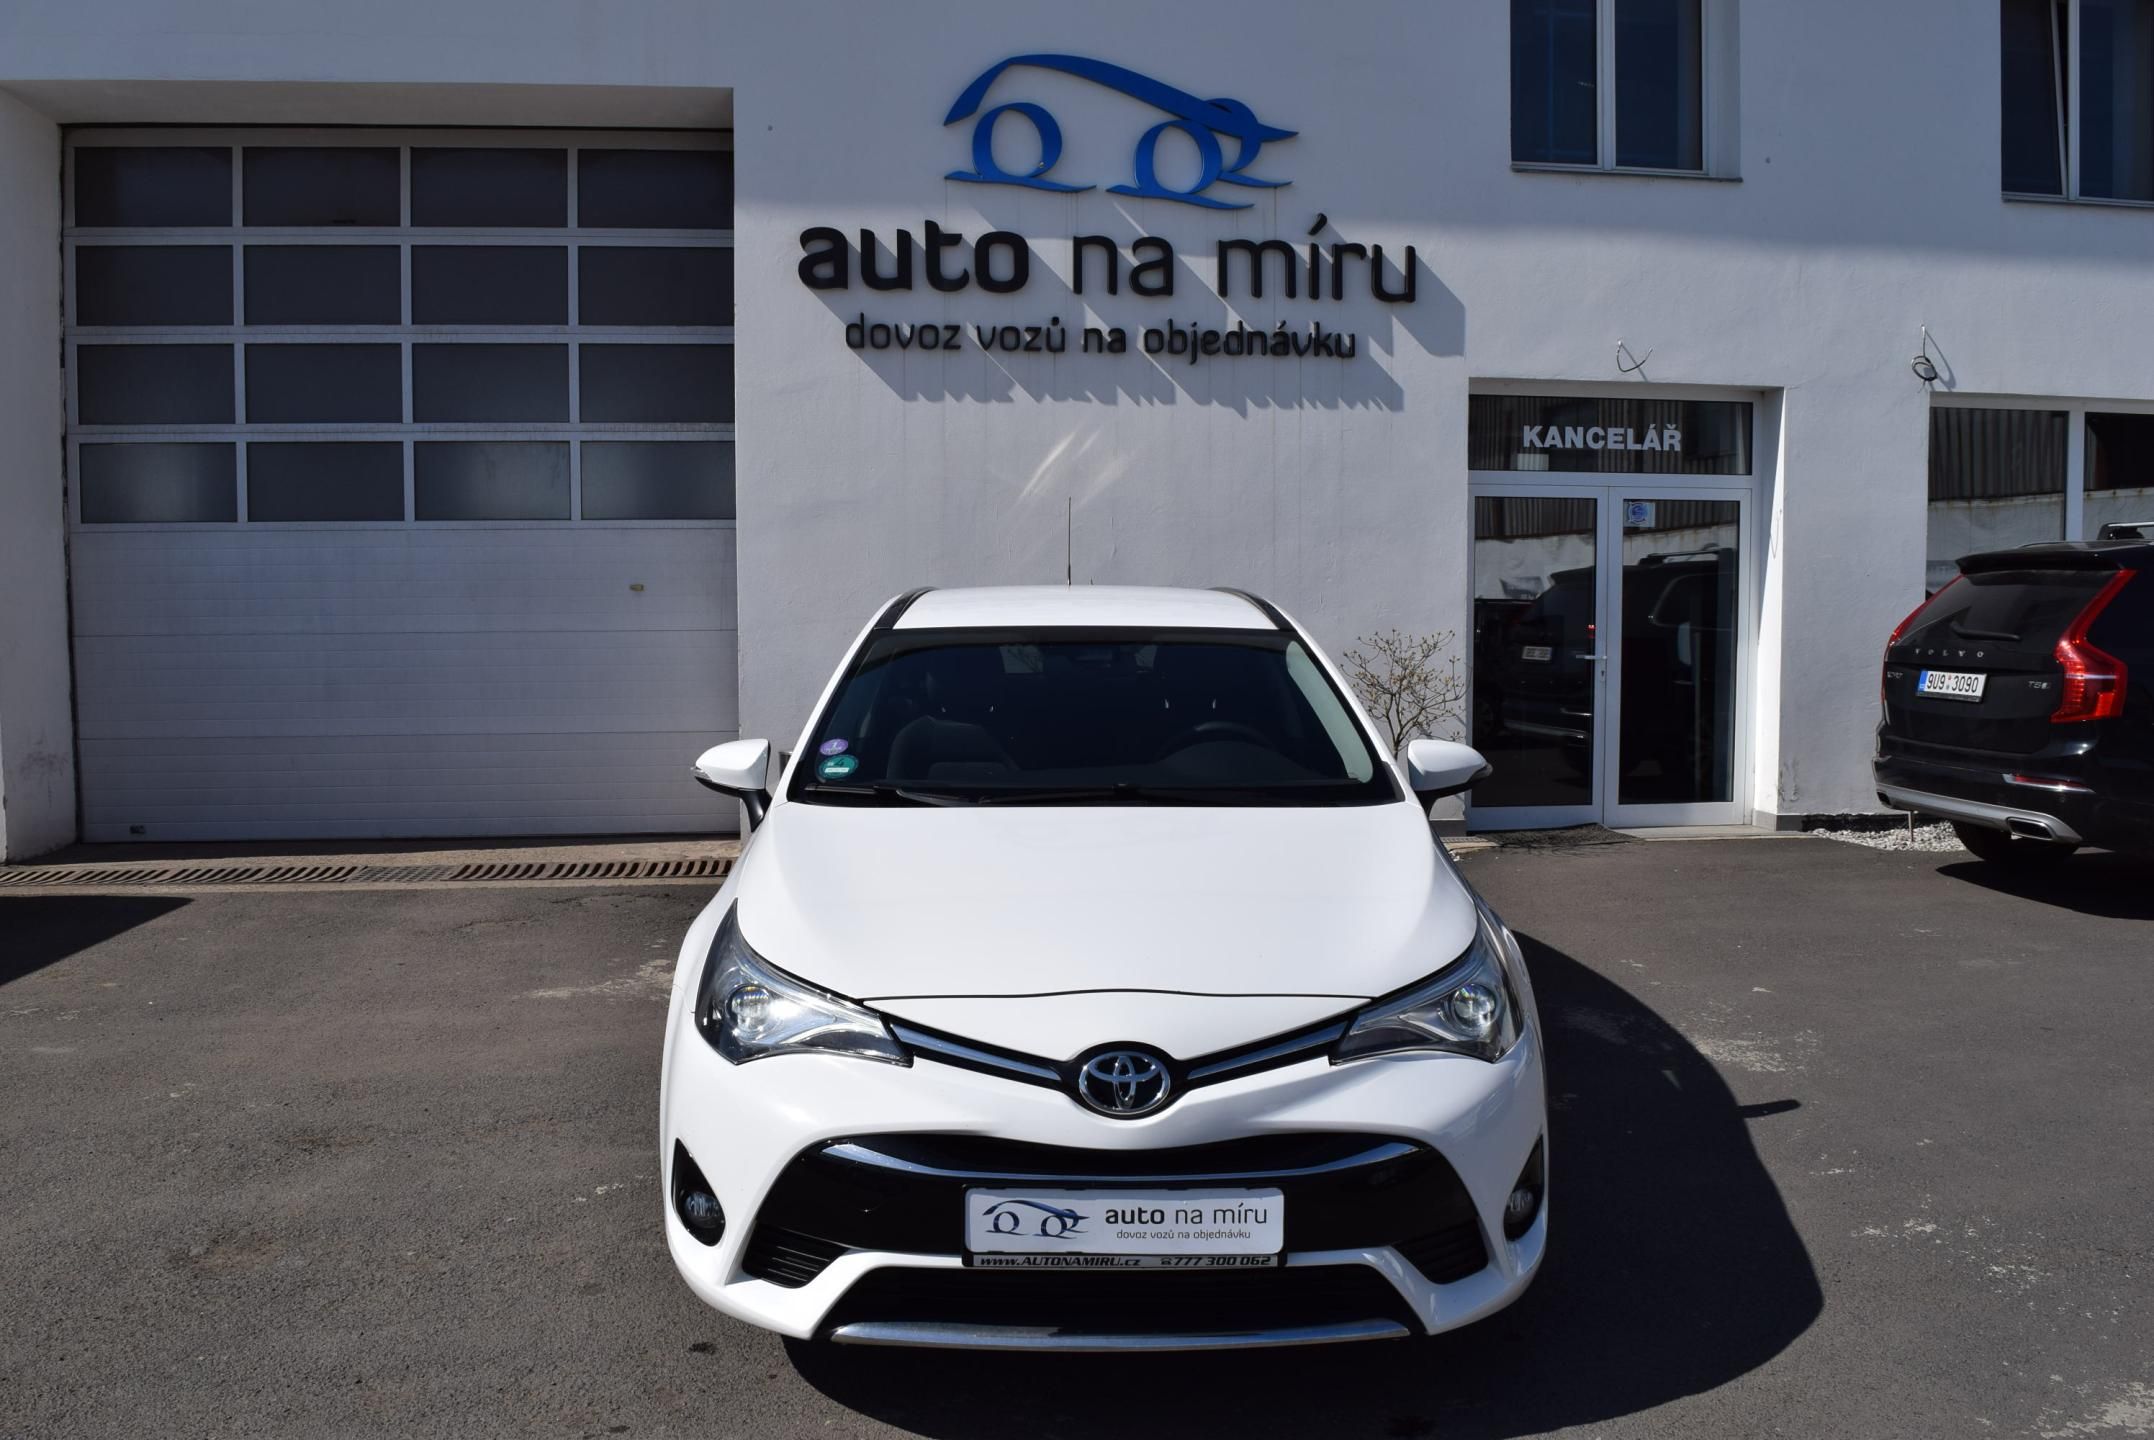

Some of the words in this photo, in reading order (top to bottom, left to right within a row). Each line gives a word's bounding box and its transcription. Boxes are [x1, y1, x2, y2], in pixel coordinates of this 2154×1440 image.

[798, 219, 1030, 293] auto
[1072, 235, 1174, 296] na
[1217, 213, 1417, 303] míru
[845, 313, 962, 351] dovoz
[976, 316, 1066, 354] vozů
[1083, 327, 1126, 354] na
[1143, 318, 1356, 365] objednávku
[1523, 423, 1682, 451] KANCELÁŘ
[1926, 673, 1946, 690] 9U9
[1952, 675, 1979, 693] 3090
[1105, 1207, 1165, 1225] auto
[1175, 1208, 1202, 1225] na
[1213, 1202, 1267, 1224] míru
[1116, 1229, 1147, 1239] dovoz
[1150, 1229, 1175, 1239] vozů
[1177, 1231, 1190, 1239] na
[1193, 1229, 1251, 1241] objednávku
[980, 1257, 1141, 1266] www.AUTONAMIRU.cz
[1174, 1256, 1203, 1266] 777
[1205, 1256, 1238, 1266] 300
[1240, 1256, 1271, 1266] 062
